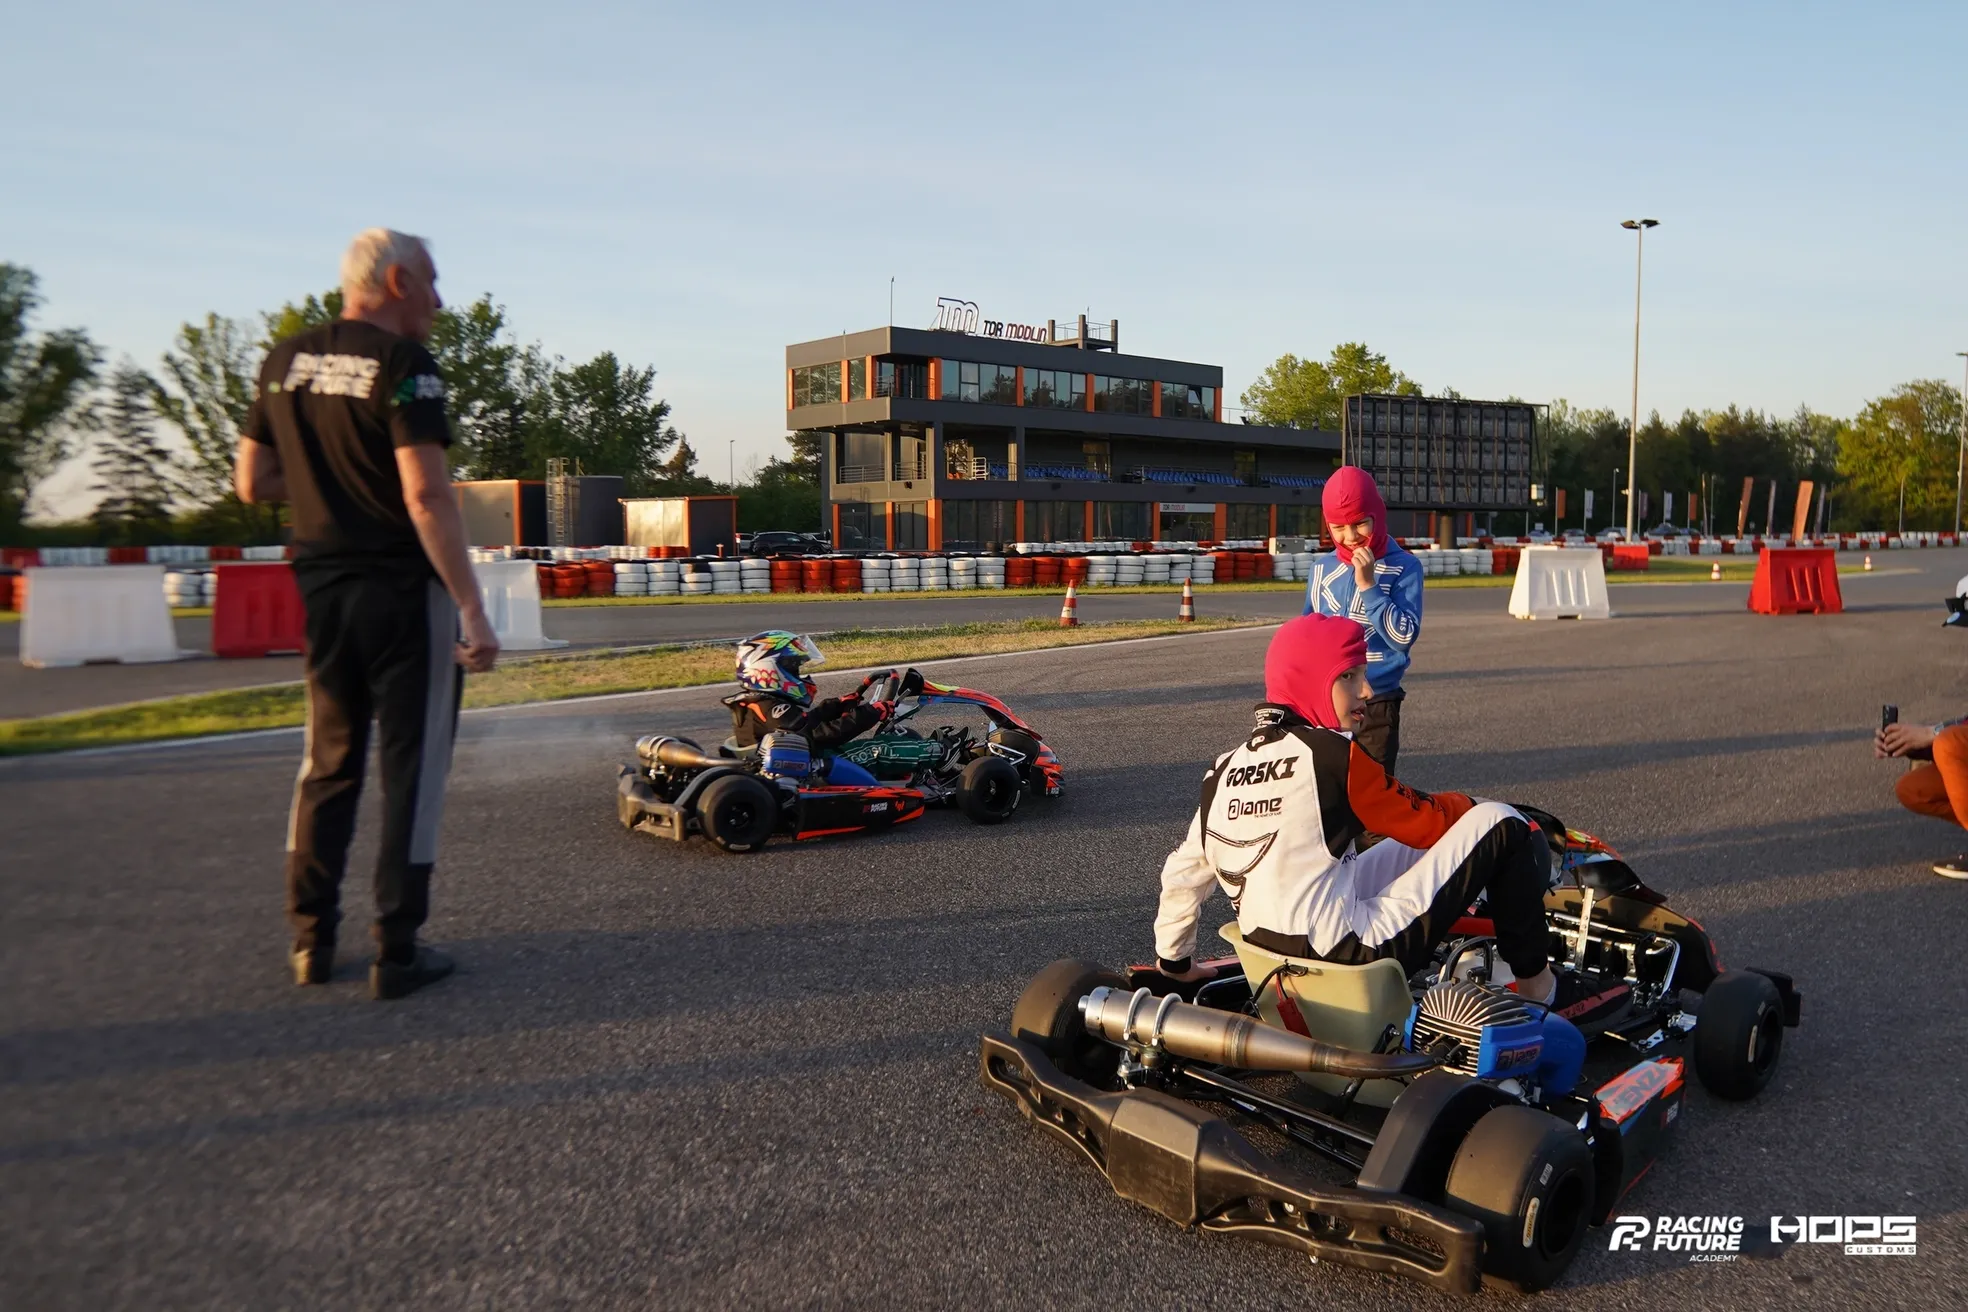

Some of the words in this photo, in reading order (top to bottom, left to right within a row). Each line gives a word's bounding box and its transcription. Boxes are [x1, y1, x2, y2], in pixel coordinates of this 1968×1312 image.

[983, 320, 1003, 337] TOR
[1005, 323, 1047, 342] MODLIN
[1226, 756, 1300, 788] GORSKI
